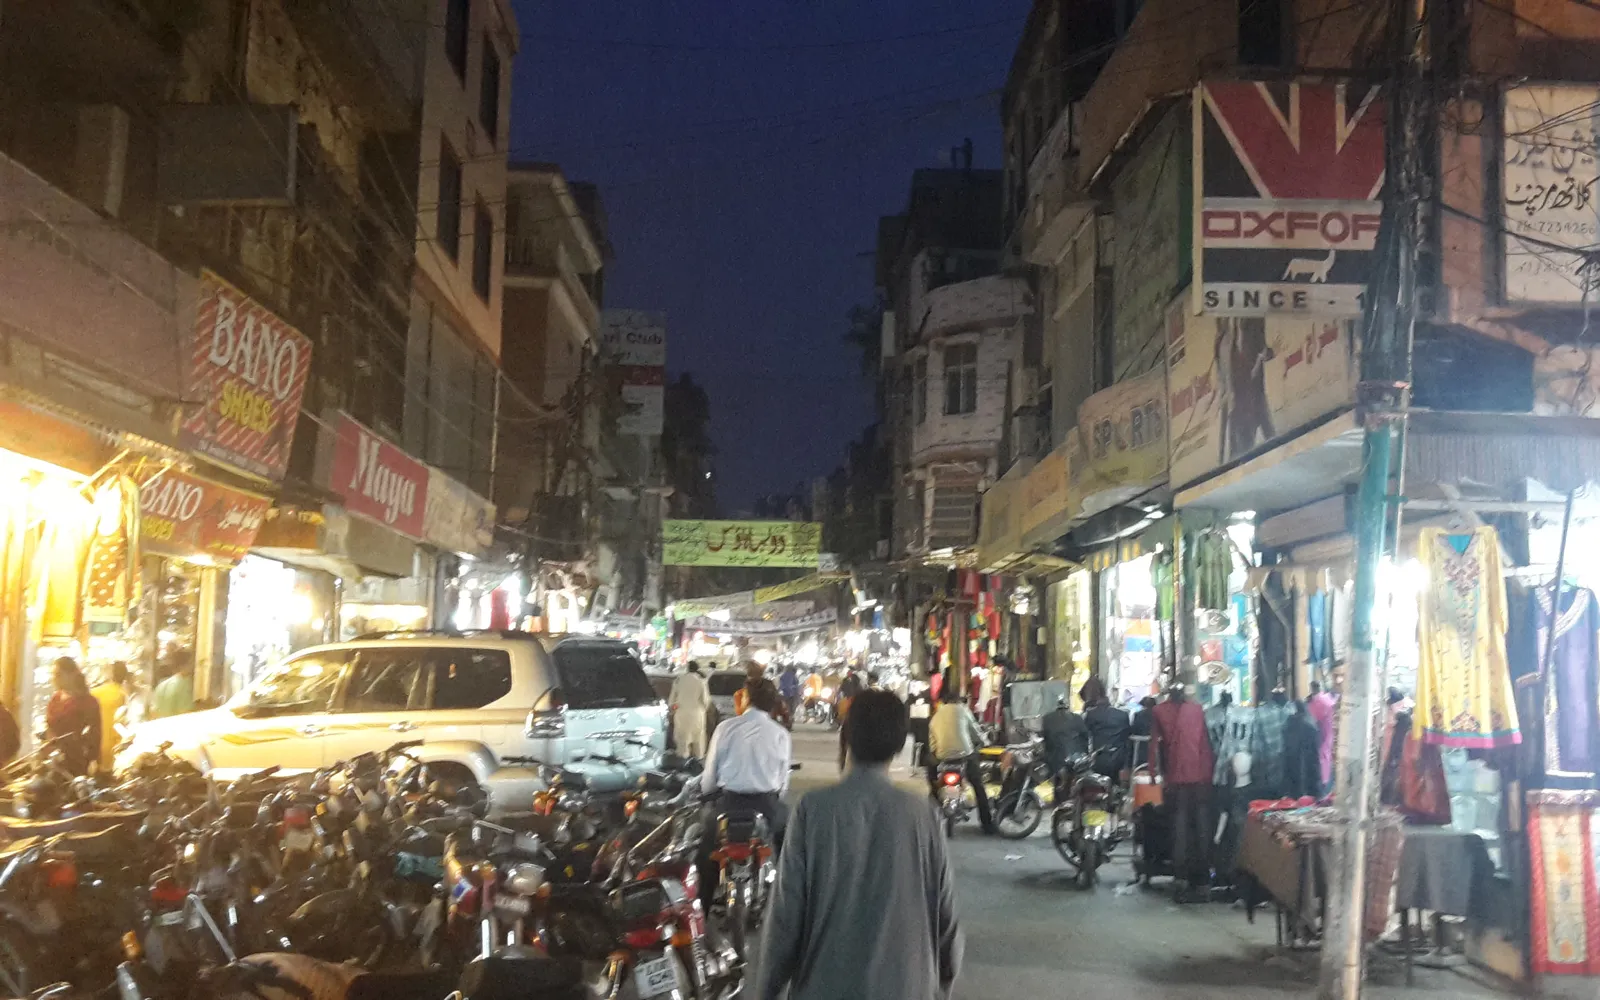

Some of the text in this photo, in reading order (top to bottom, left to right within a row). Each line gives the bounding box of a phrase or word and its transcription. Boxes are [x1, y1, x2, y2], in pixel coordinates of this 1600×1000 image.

[1204, 290, 1309, 309] SINCE
[208, 296, 298, 400] BANO
[219, 380, 273, 434] SHOES
[140, 475, 204, 522] BANO
